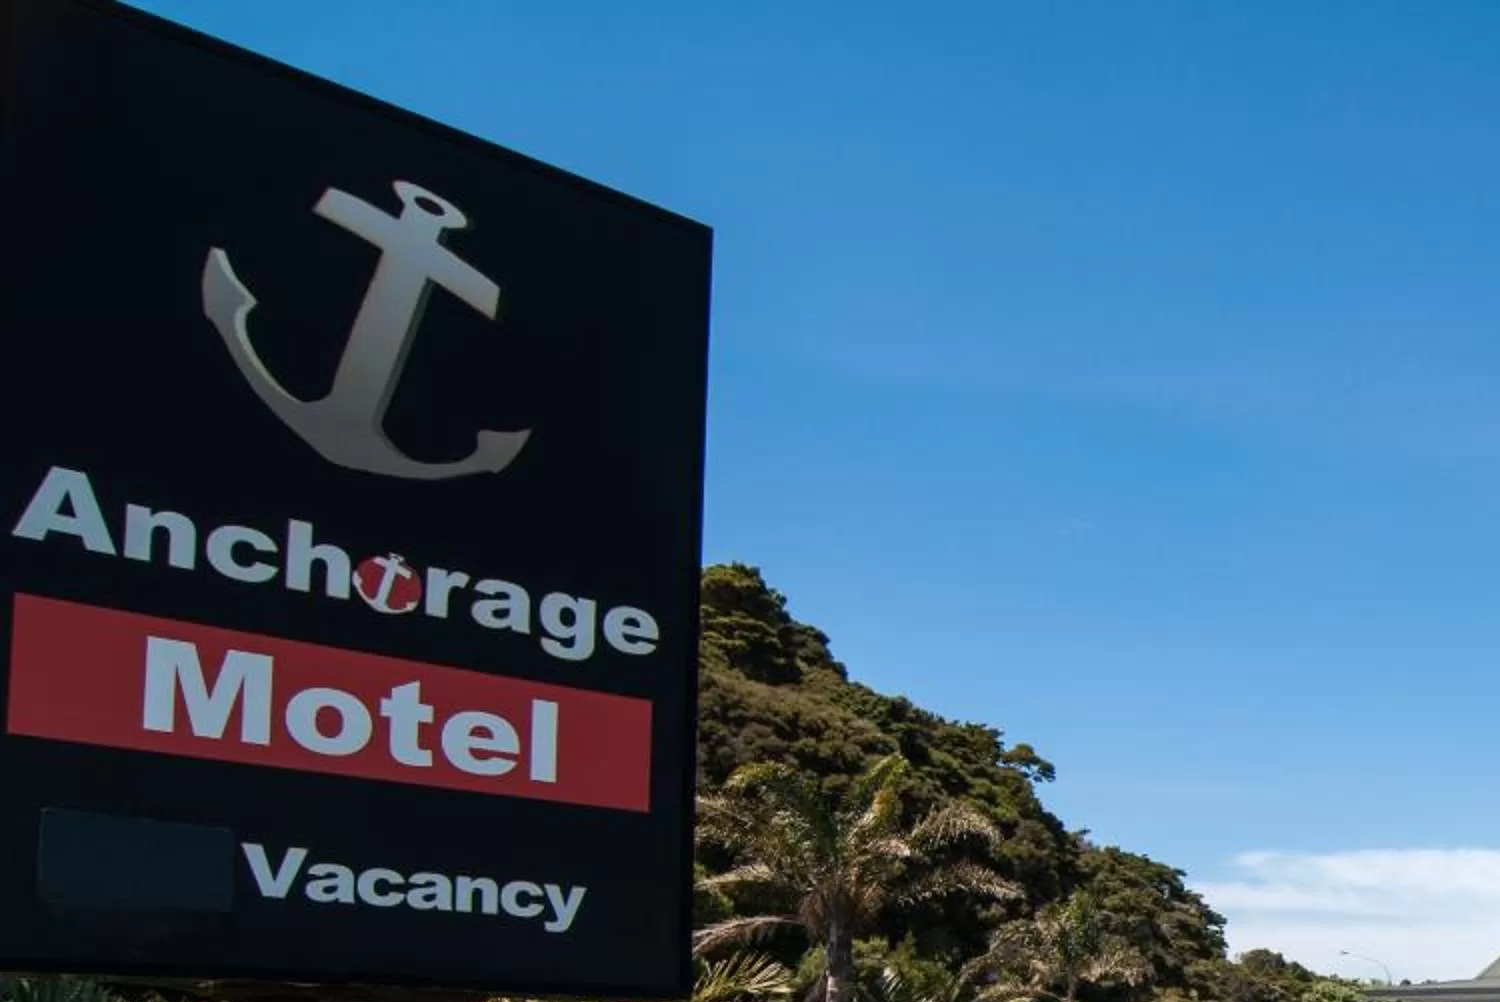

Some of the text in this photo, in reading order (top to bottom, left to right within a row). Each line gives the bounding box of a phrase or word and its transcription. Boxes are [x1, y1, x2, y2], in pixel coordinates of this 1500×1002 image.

[13, 466, 658, 661] Anchorage
[142, 635, 558, 783] Motel
[241, 842, 586, 933] Vacancy
